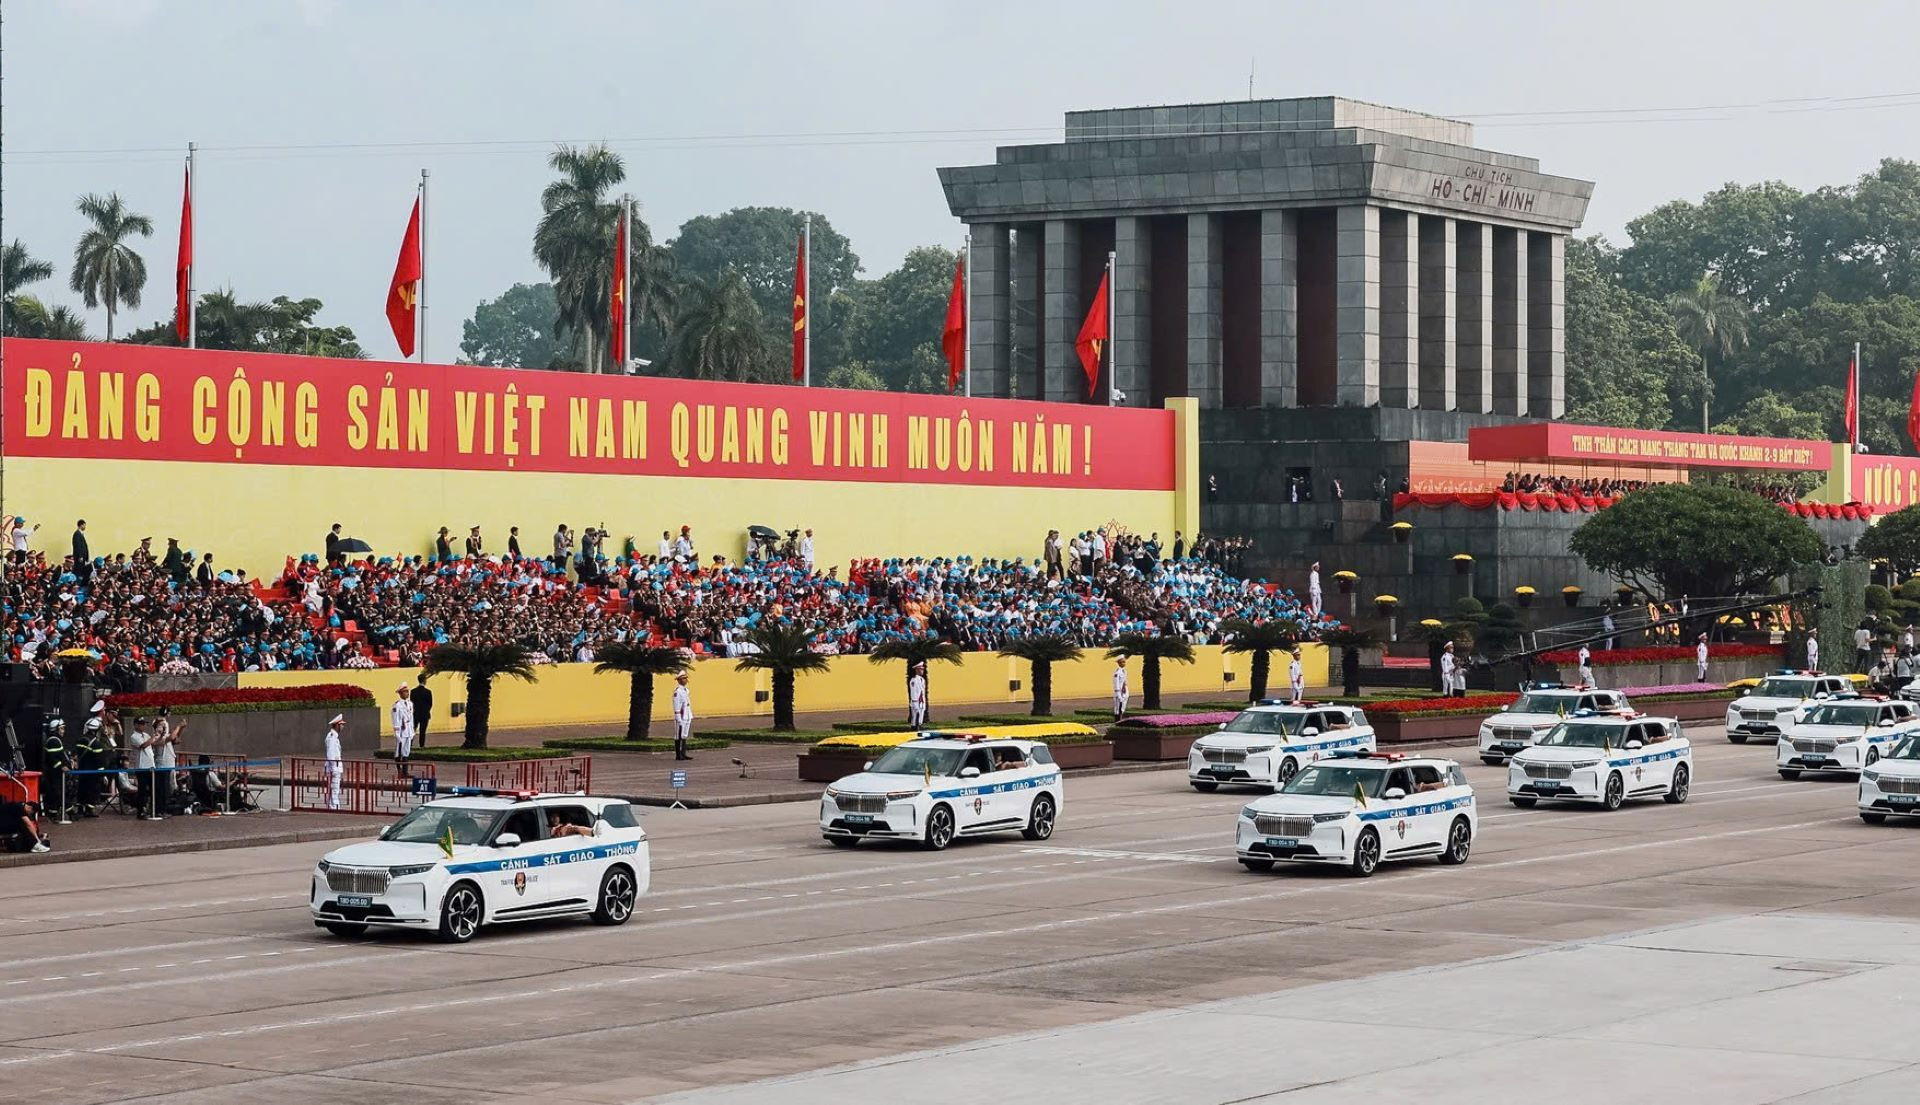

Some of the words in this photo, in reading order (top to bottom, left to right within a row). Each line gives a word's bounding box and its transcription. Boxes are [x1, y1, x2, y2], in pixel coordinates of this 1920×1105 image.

[25, 352, 161, 442] ĐẢNG
[193, 367, 318, 458] CỘNG
[347, 371, 429, 451] SẢN
[455, 383, 545, 467] VIỆT
[569, 396, 648, 460] NAM
[670, 402, 789, 468] QUANG
[809, 411, 888, 468] VINH
[908, 409, 994, 472] MUÔN
[1013, 413, 1072, 475] NĂM
[1572, 435, 1593, 452] TINH
[1594, 432, 1617, 454] THẦN
[1618, 436, 1639, 455] CÁCH
[1640, 440, 1662, 458] MẠNG
[1663, 439, 1689, 458] THÁNG
[1720, 441, 1738, 461] QUỐC
[1739, 444, 1763, 462] KHÁNH
[1864, 463, 1901, 505] NƯỚC
[1012, 782, 1029, 791] GIAO
[1430, 804, 1446, 814] GIAO
[543, 854, 562, 866] SÁT
[569, 851, 594, 863] GIAO
[604, 844, 635, 857] THÔNG
